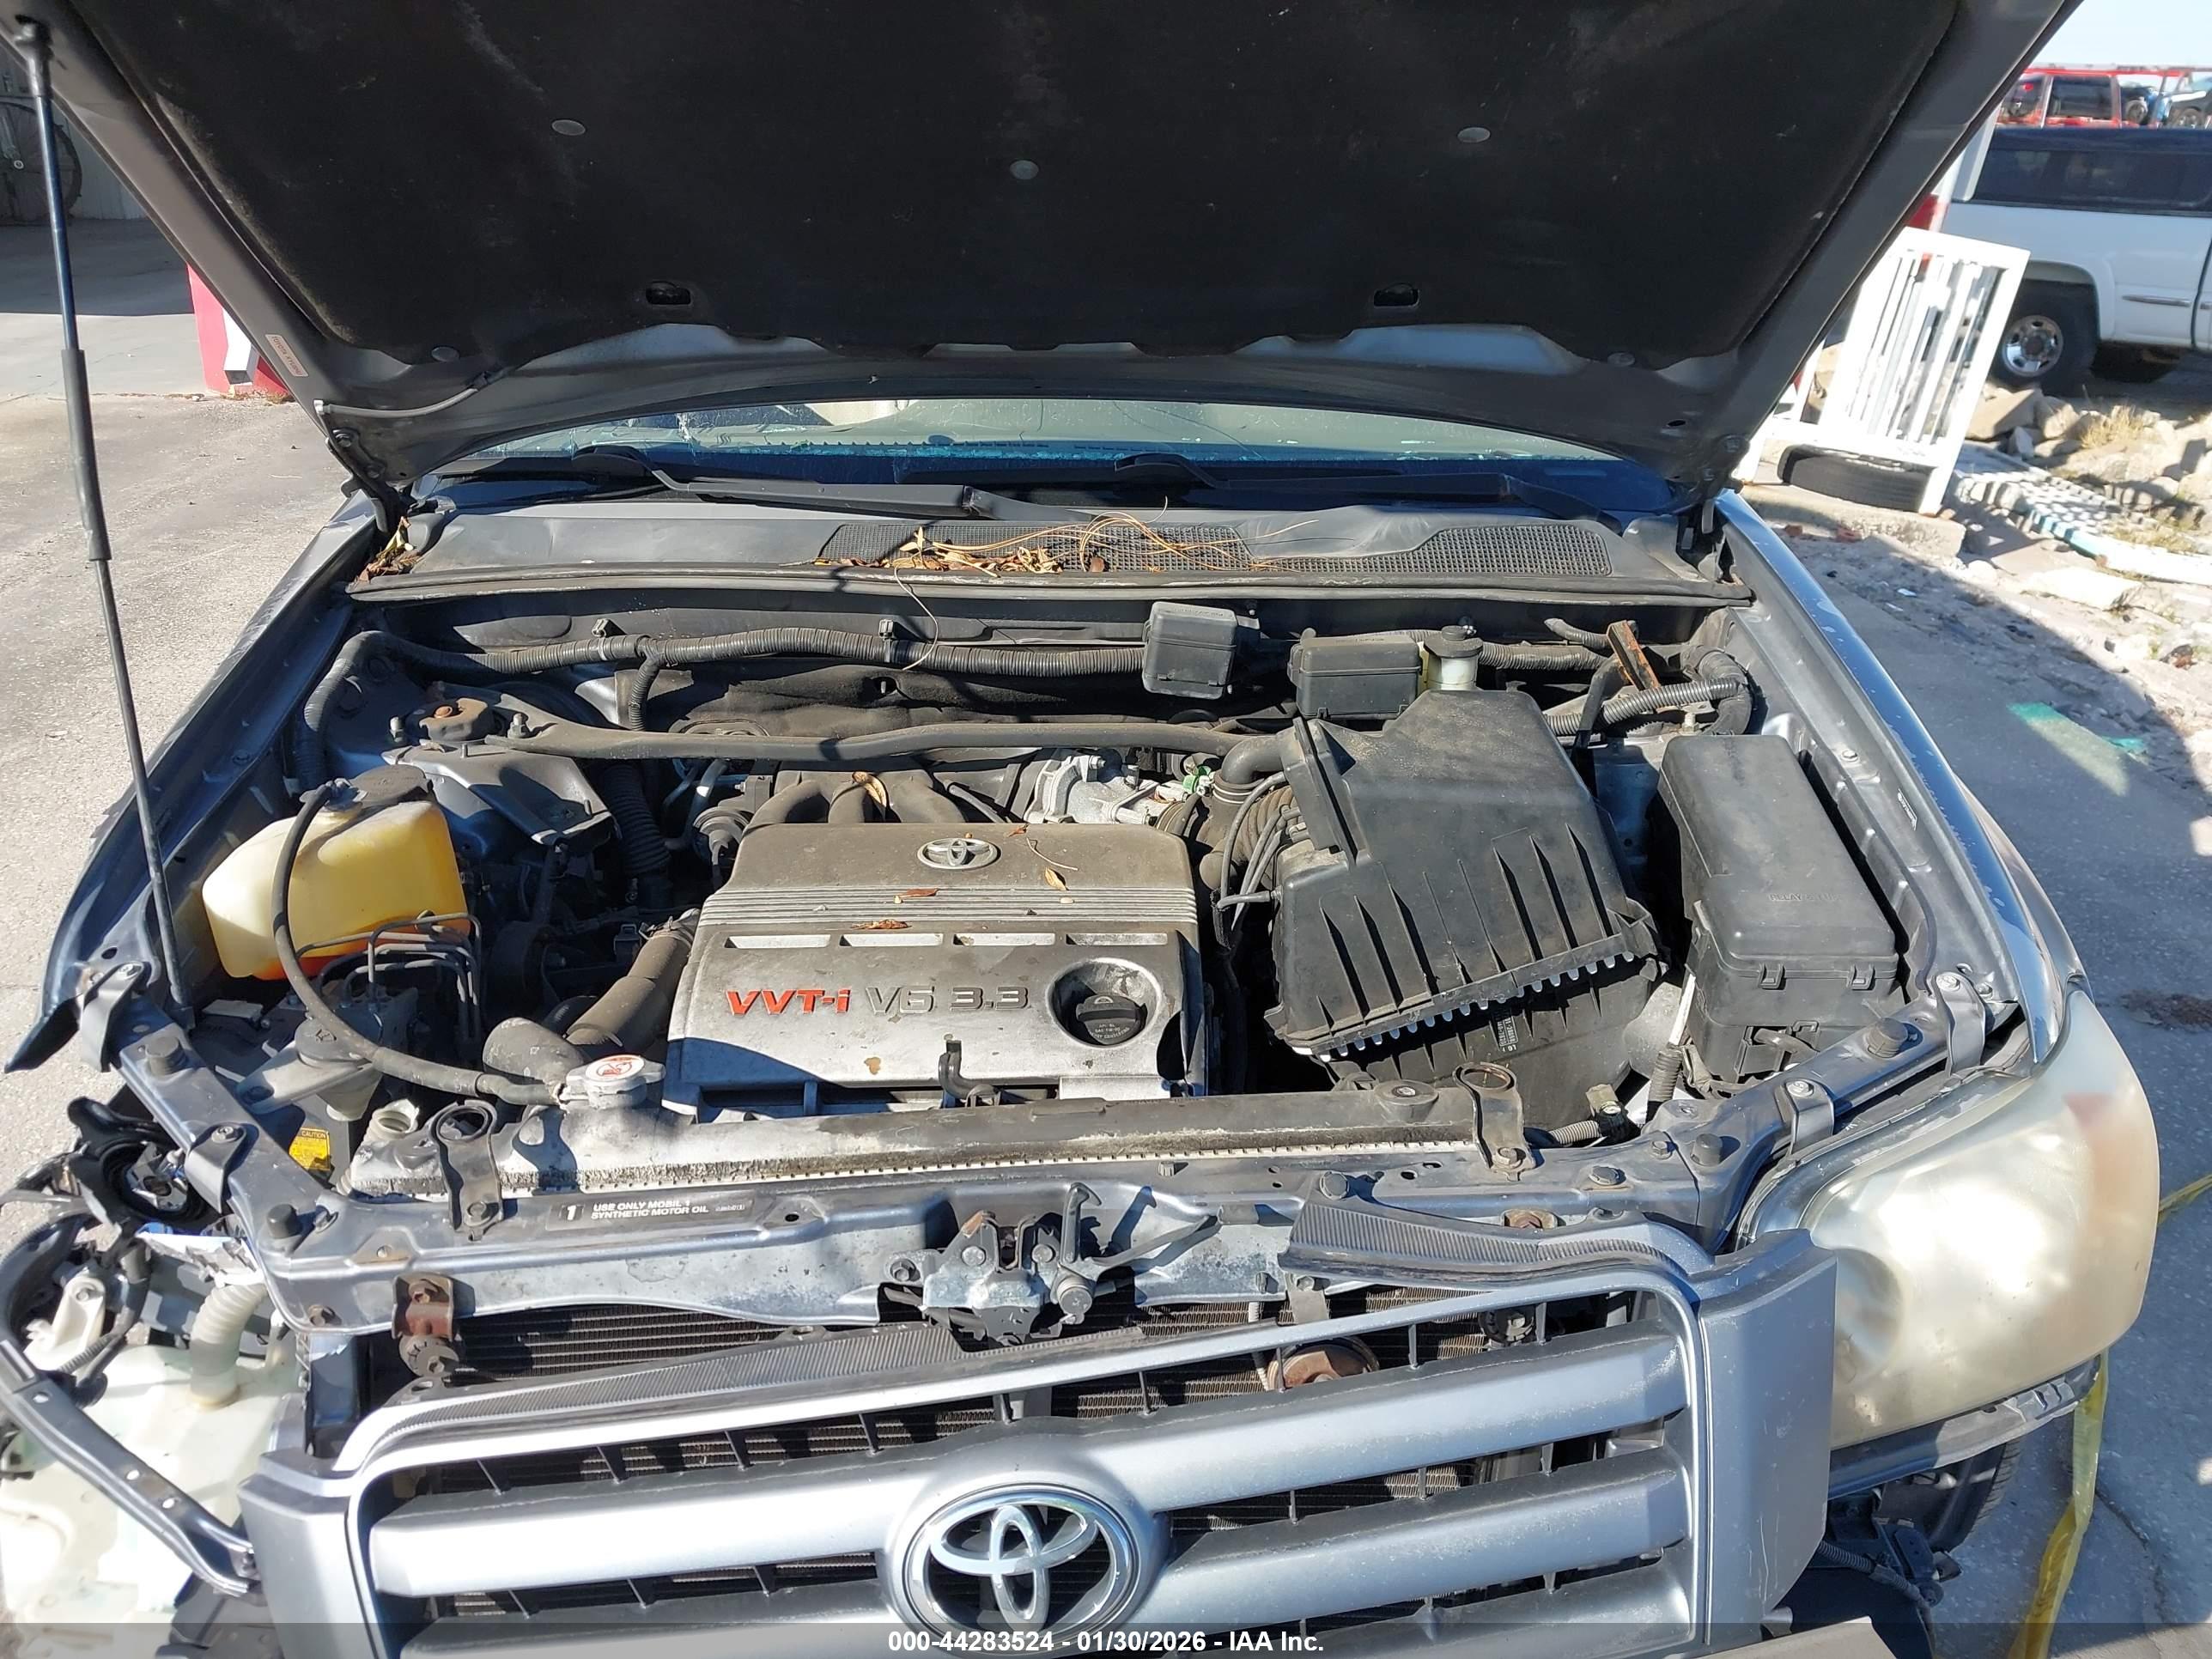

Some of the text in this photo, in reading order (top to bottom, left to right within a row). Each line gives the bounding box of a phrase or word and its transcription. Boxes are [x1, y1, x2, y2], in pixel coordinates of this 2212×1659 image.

[725, 987, 1029, 1016] VVT-i V6 3.3
[301, 1130, 326, 1139] CAUTION
[593, 1203, 616, 1212] USE
[617, 1202, 647, 1211] ONLY
[647, 1200, 683, 1209] MOBIL
[592, 1209, 651, 1219] SYNTHETIC
[651, 1206, 690, 1216] MOTOR
